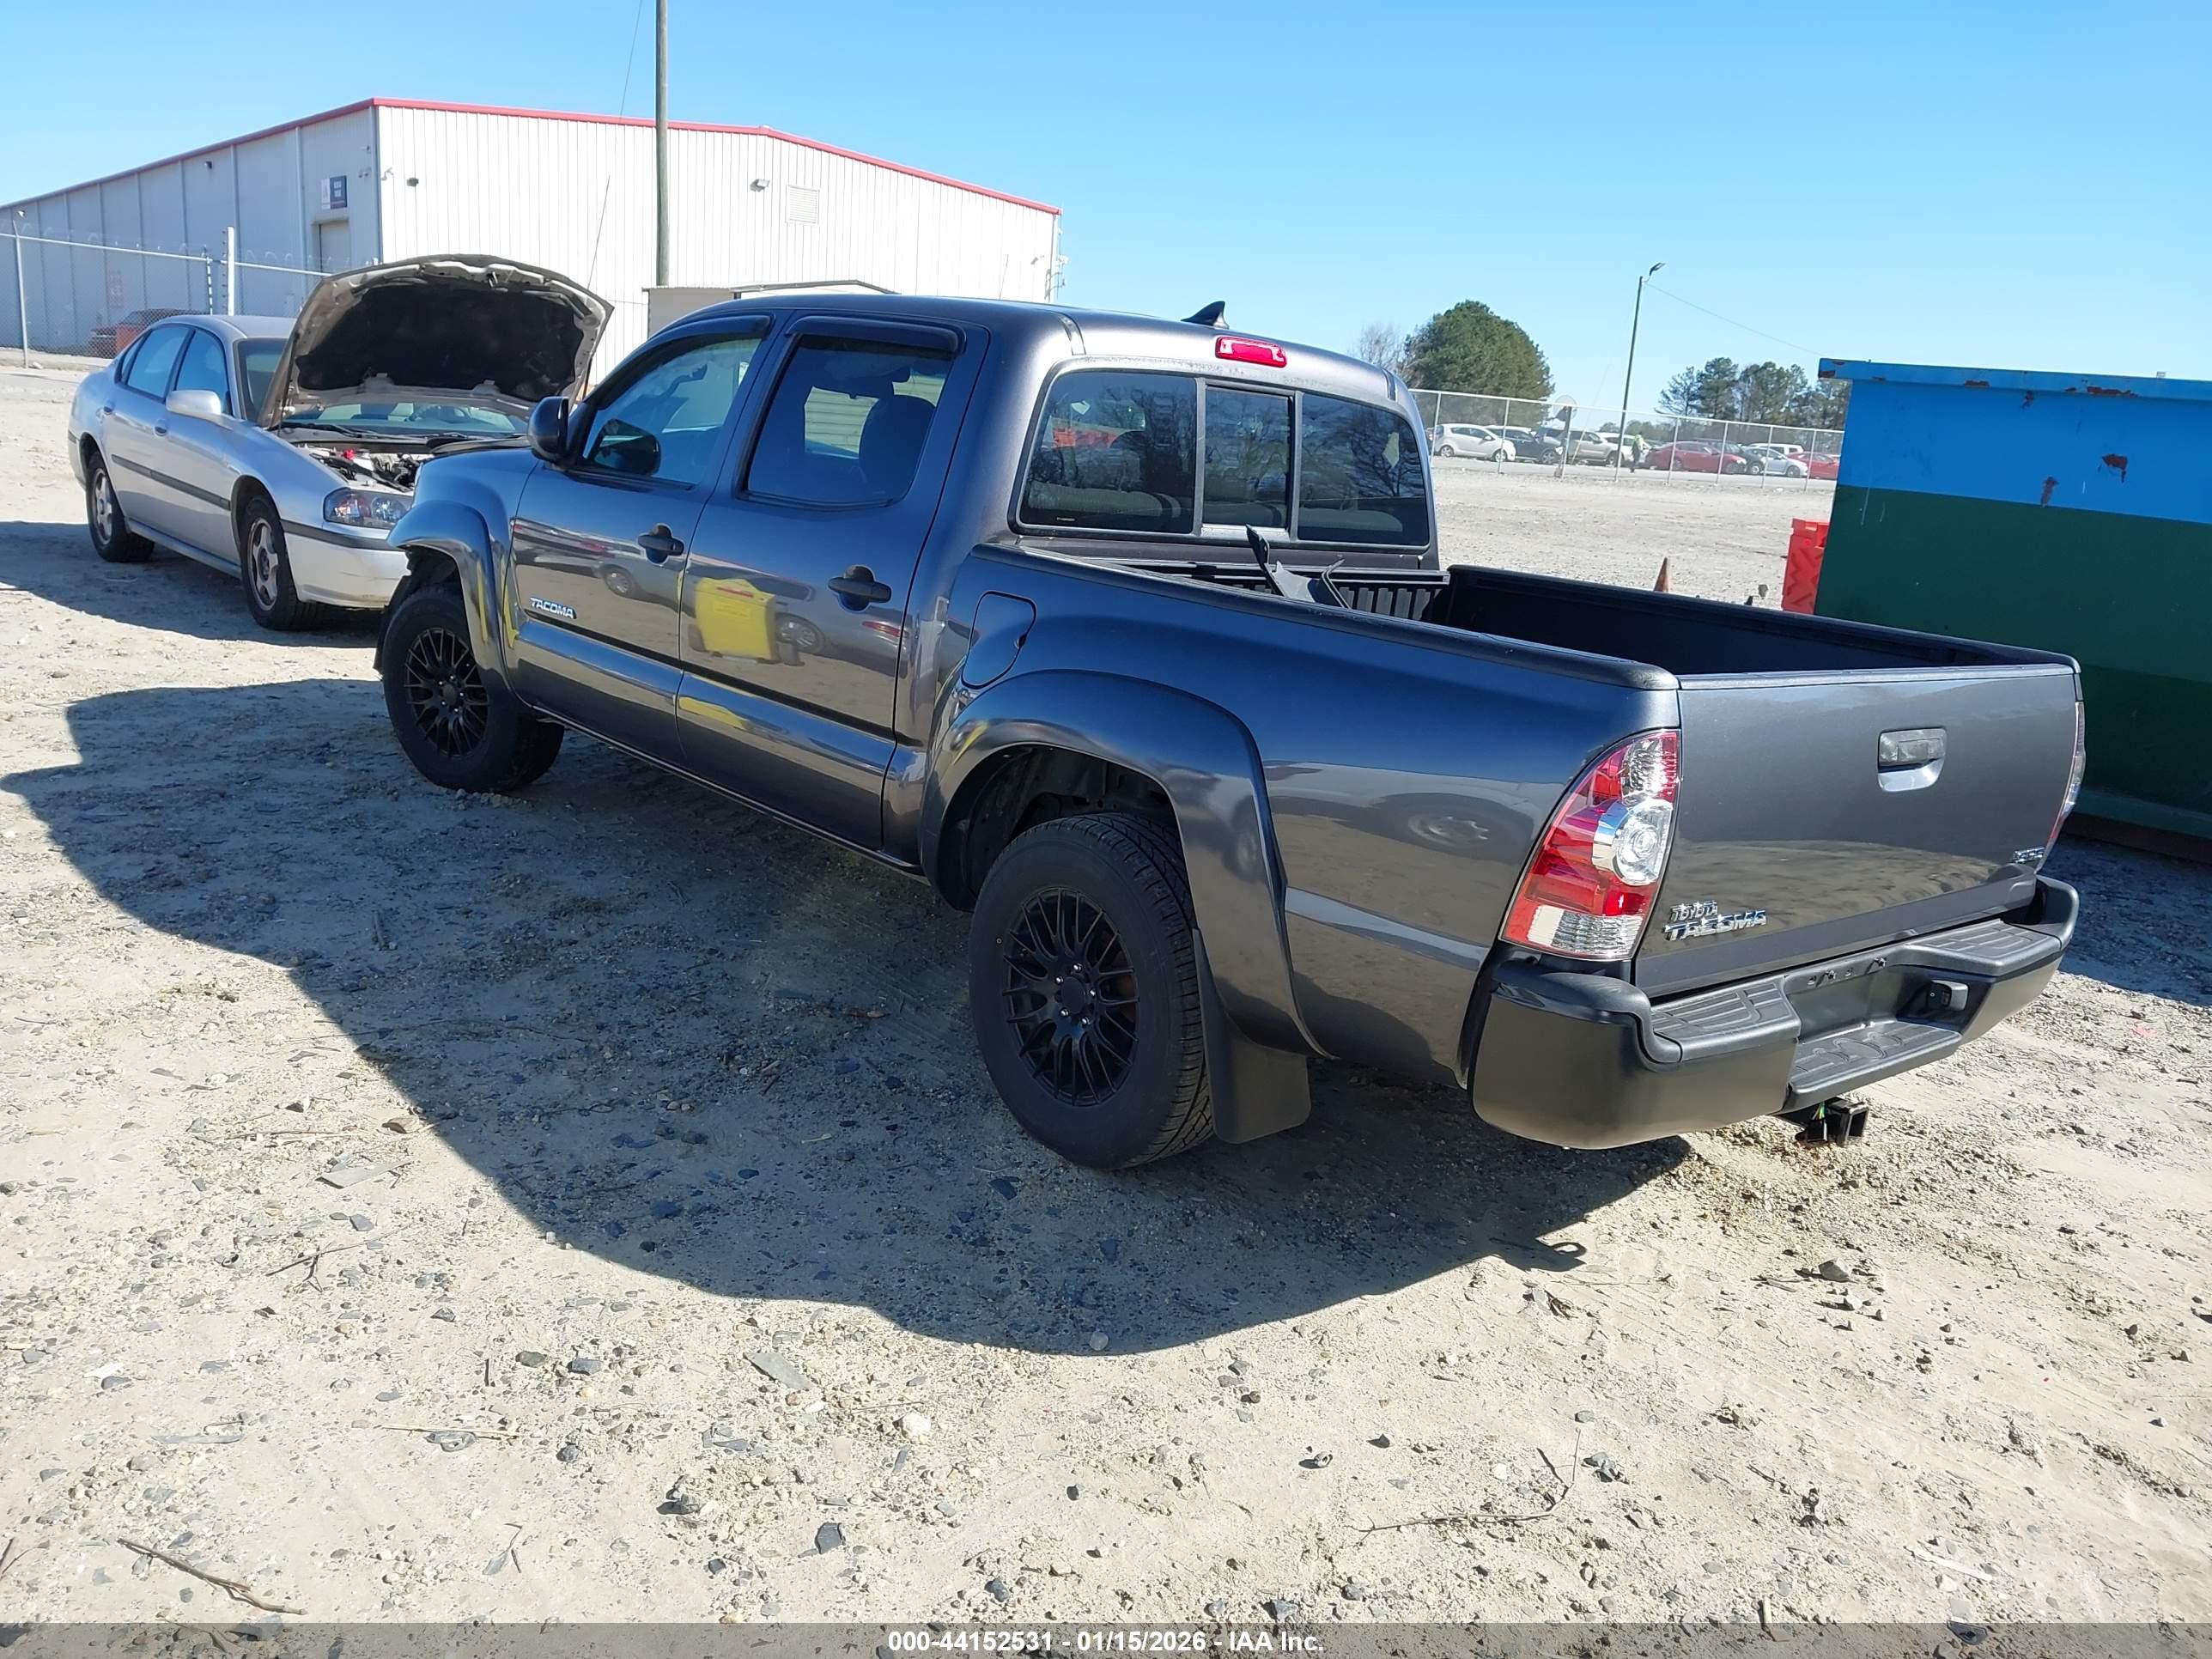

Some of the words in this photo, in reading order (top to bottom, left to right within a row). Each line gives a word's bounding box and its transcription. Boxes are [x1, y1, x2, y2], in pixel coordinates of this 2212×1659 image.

[529, 597, 576, 619] TACOMA
[1670, 900, 1718, 922] TOYOTA
[1663, 909, 1766, 941] TACOMA
